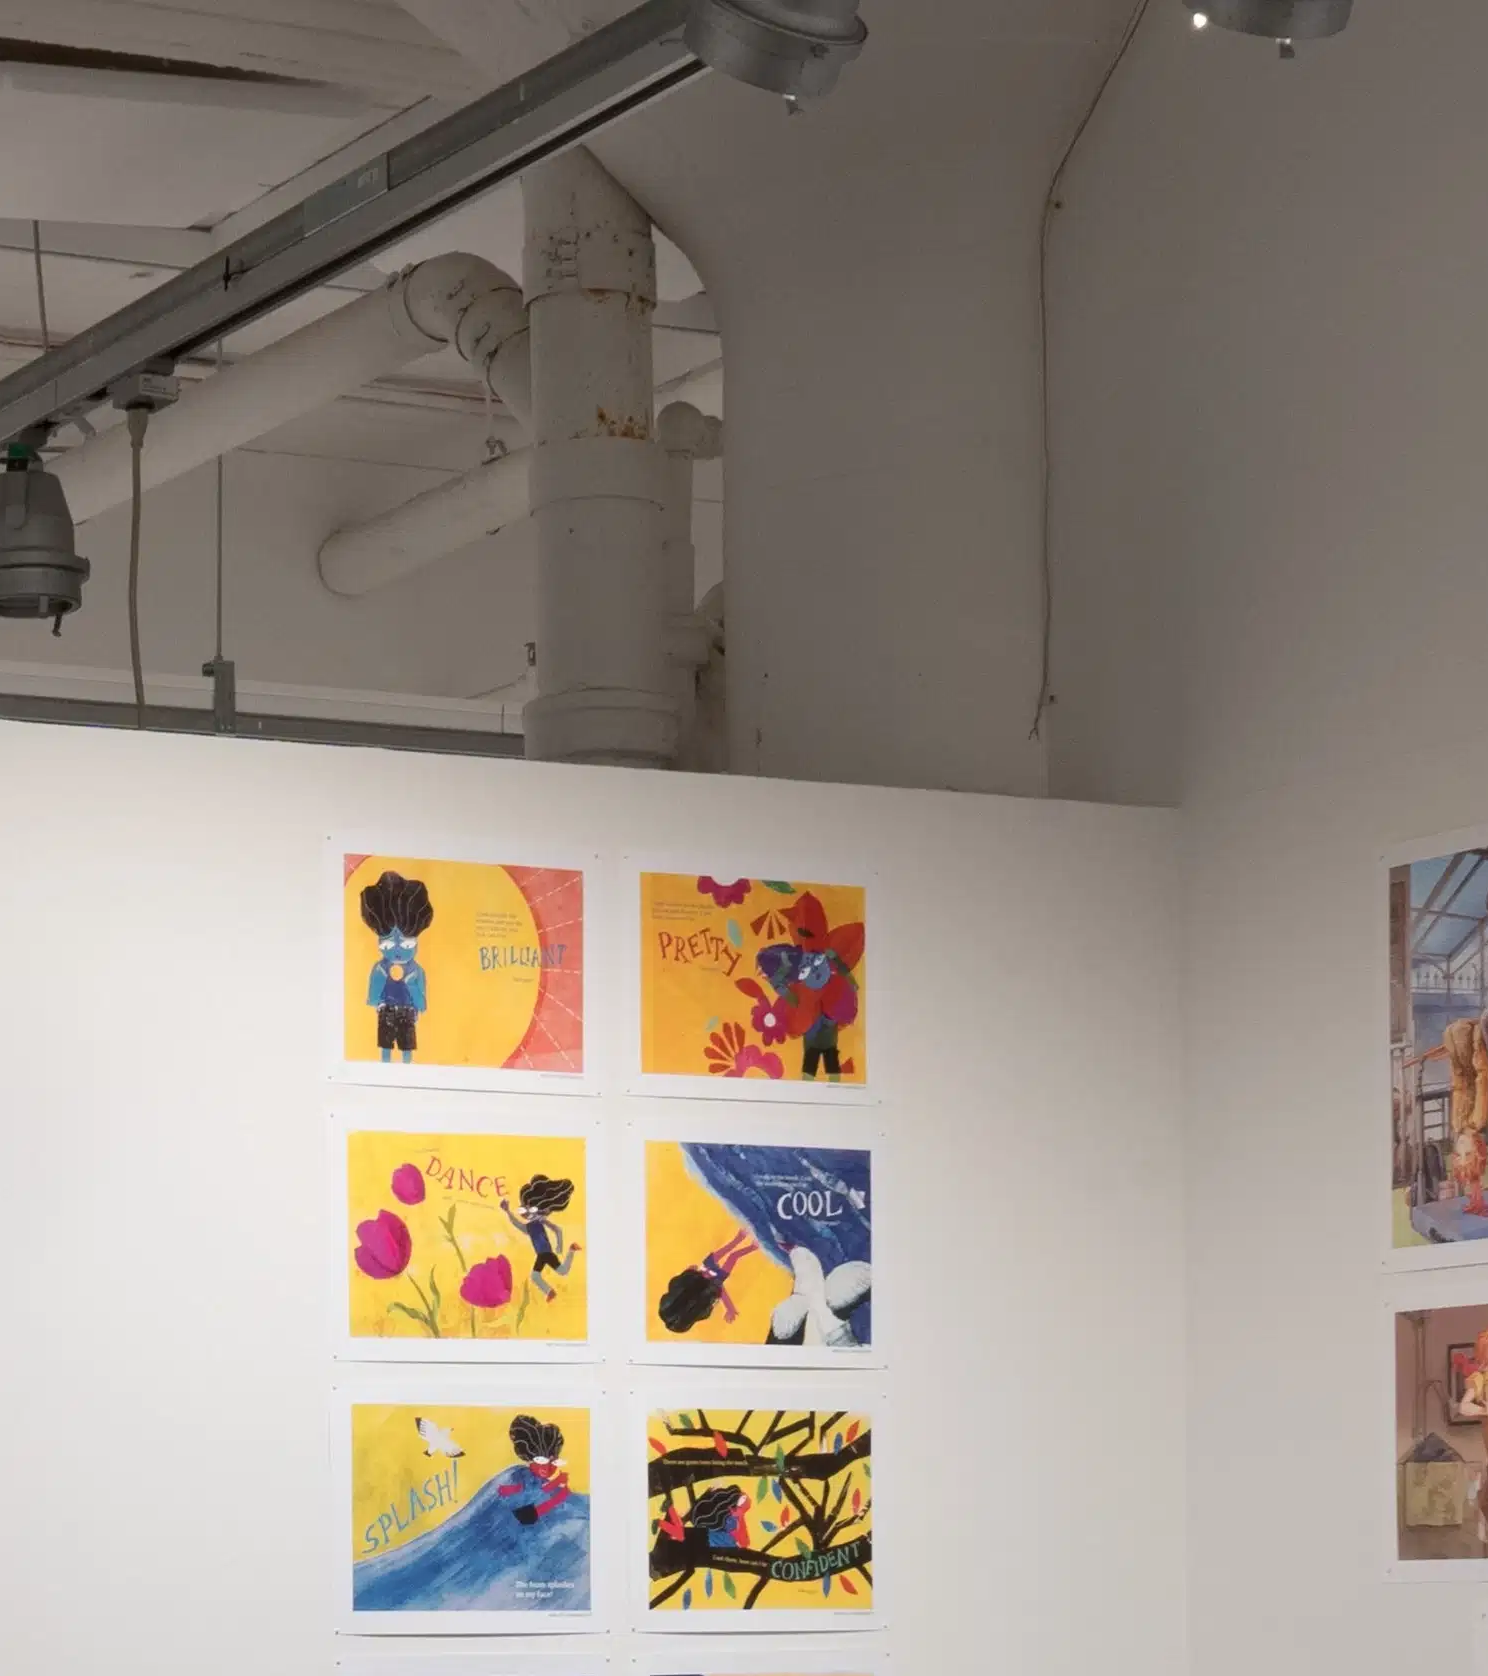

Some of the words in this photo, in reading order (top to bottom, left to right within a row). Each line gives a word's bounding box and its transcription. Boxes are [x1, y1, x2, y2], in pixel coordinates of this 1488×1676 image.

[478, 944, 567, 971] BRILLIANT
[658, 927, 742, 977] PRETTY
[425, 1155, 510, 1198] DANCE
[777, 1190, 843, 1220] COOL
[361, 1459, 459, 1554] SPLASH!
[771, 1541, 861, 1581] CONFIDENT
